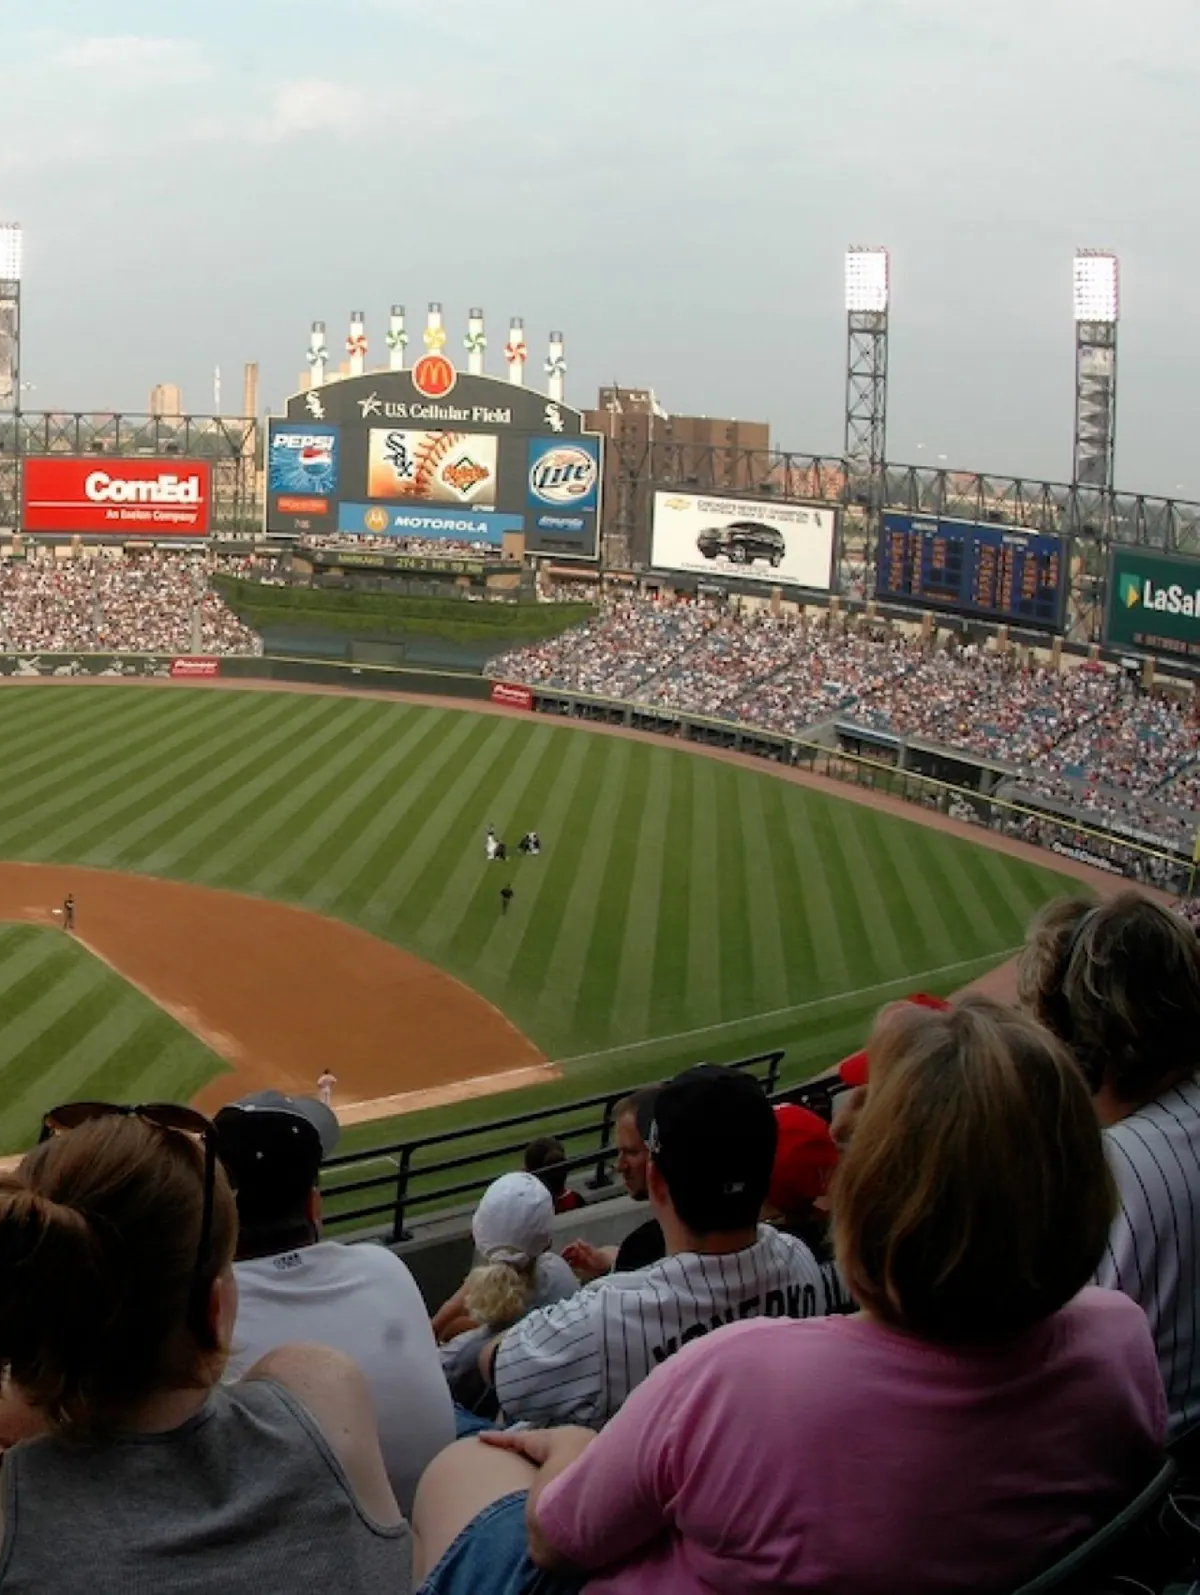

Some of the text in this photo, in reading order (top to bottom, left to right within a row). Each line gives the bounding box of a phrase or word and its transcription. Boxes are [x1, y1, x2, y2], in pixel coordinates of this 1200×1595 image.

[409, 403, 471, 421] Cellular
[472, 406, 512, 424] Field
[273, 433, 335, 450] PEPSI
[538, 463, 588, 489] Lite
[85, 471, 200, 503] ComEd
[106, 510, 119, 520] An
[153, 510, 197, 523] Company
[394, 516, 489, 533] MOTOROLA
